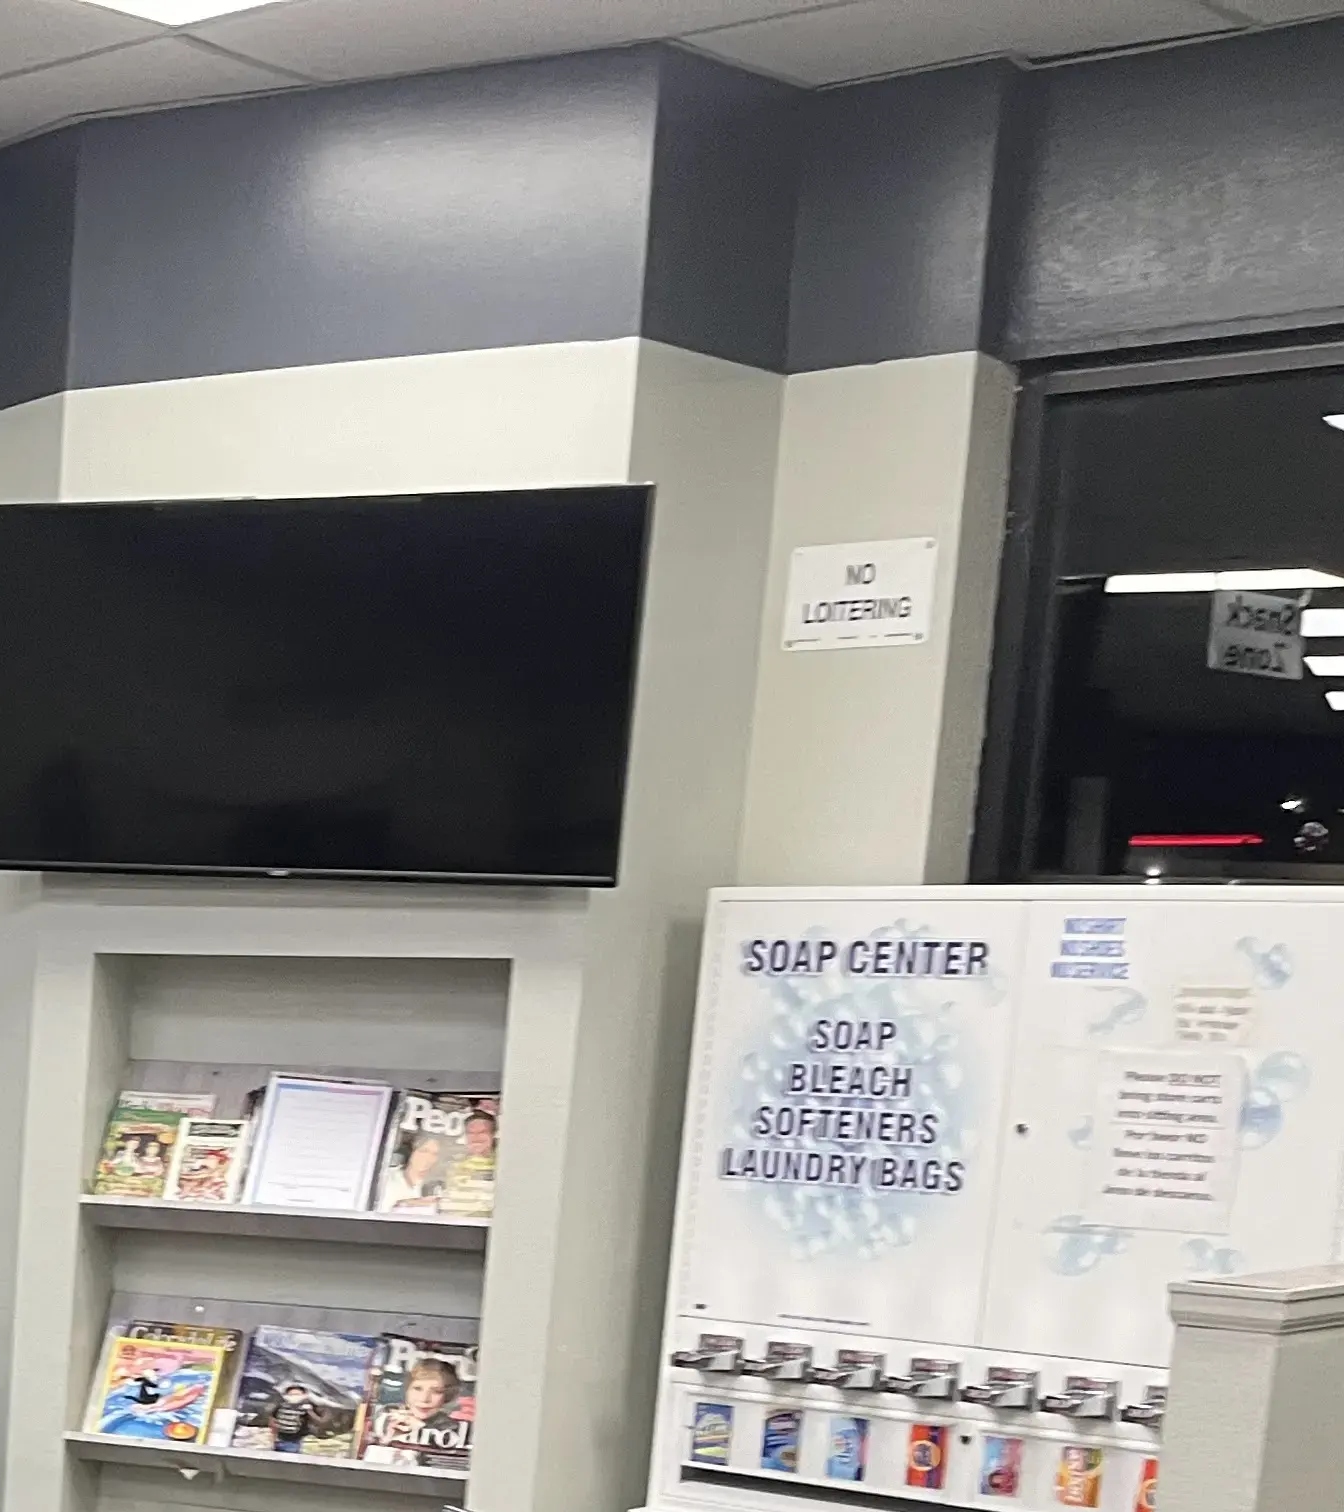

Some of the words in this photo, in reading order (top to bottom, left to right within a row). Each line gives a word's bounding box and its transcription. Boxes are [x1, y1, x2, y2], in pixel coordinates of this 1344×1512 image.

[846, 562, 876, 585] NO
[802, 596, 911, 624] LOITERING
[747, 939, 837, 973] SOAP
[847, 940, 990, 975] CENTER
[812, 1019, 896, 1051] SOAP
[787, 1063, 912, 1098] BLEACH
[401, 1096, 470, 1144] Peo
[756, 1105, 940, 1144] SOFTENERS
[722, 1147, 866, 1185] LAUNDRY
[877, 1157, 964, 1193] BAGS
